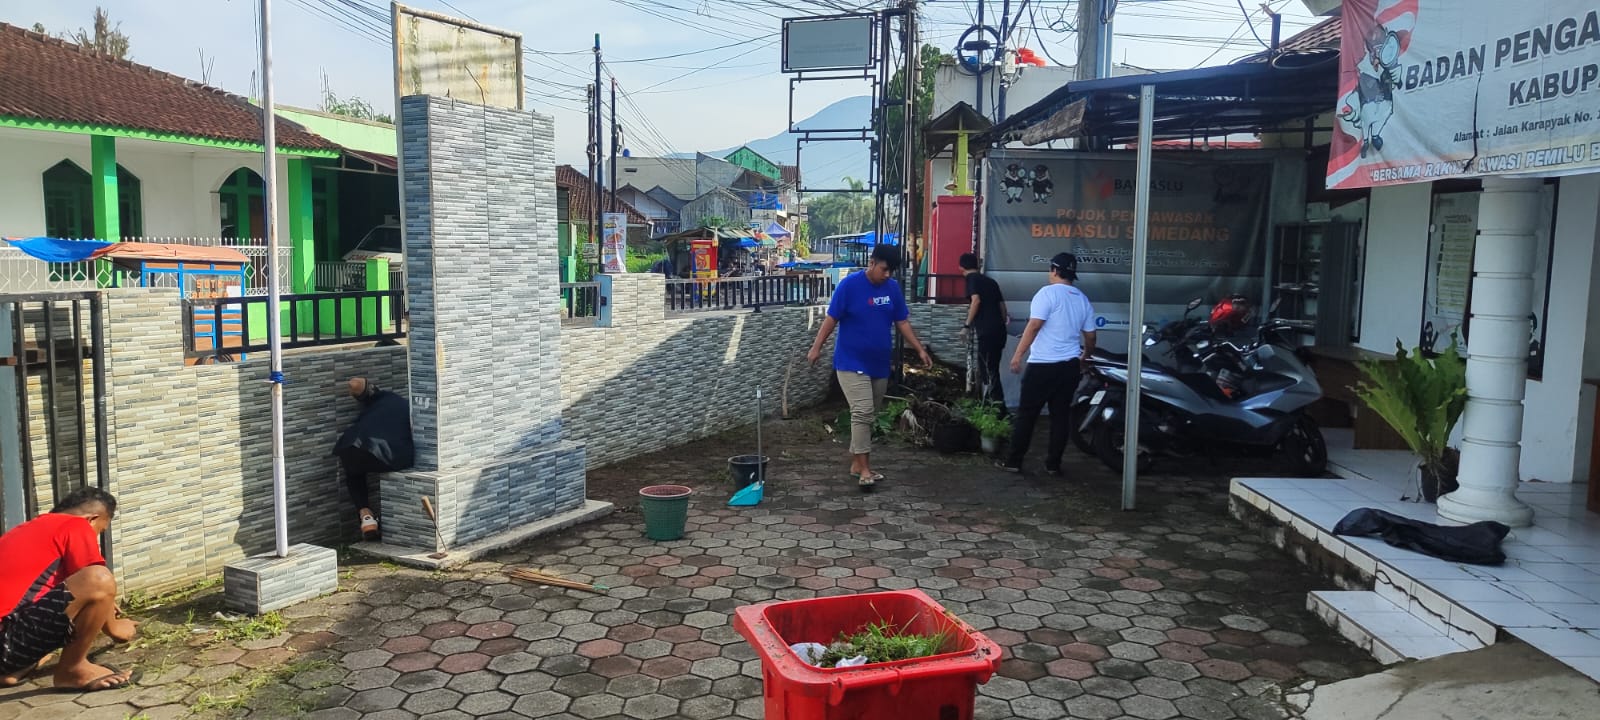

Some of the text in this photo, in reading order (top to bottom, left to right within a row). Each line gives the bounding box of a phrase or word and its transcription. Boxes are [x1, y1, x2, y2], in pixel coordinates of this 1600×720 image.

[1405, 10, 1600, 91] BADAN PENGA
[1509, 63, 1600, 106] KABUP
[1453, 129, 1484, 143] Alamat
[1493, 124, 1518, 137] Jalan
[1521, 113, 1571, 132] Karapyak
[1574, 111, 1592, 124] No.
[1424, 159, 1474, 177] RAKYT
[1477, 152, 1522, 174] AWASI
[1525, 144, 1585, 168] PEMILU
[1114, 178, 1184, 192] BAASLU
[1056, 208, 1215, 224] POJOK PEAWASAN
[1031, 223, 1231, 241] BAWASLU SMEDANG
[1075, 255, 1120, 265] AWASLU
